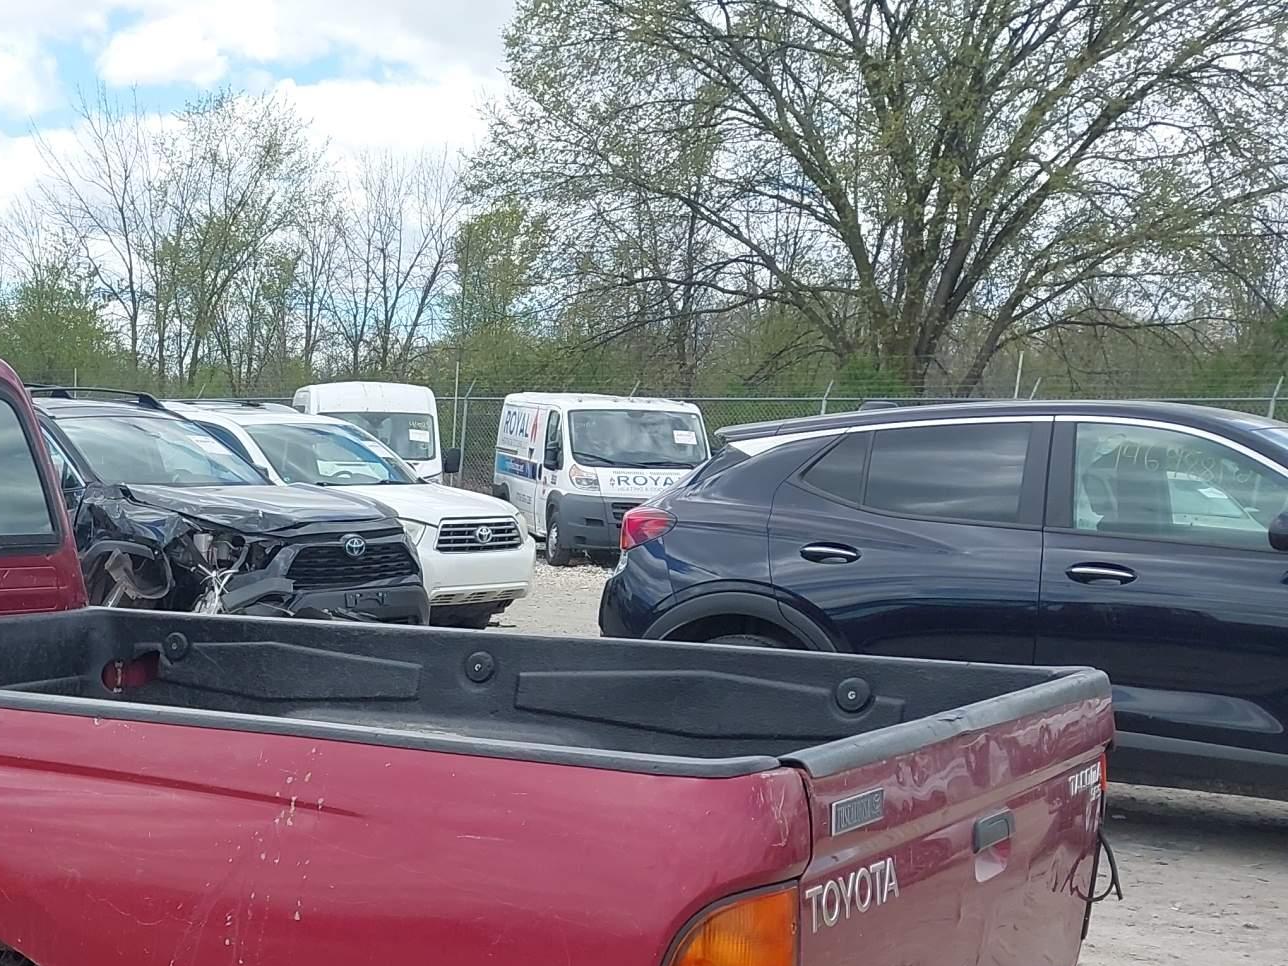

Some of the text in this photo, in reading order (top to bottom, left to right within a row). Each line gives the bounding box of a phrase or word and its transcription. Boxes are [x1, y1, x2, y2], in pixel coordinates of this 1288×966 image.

[503, 409, 530, 438] ROYAL
[617, 475, 681, 487] ROYA
[805, 857, 900, 934] TOYOTA
